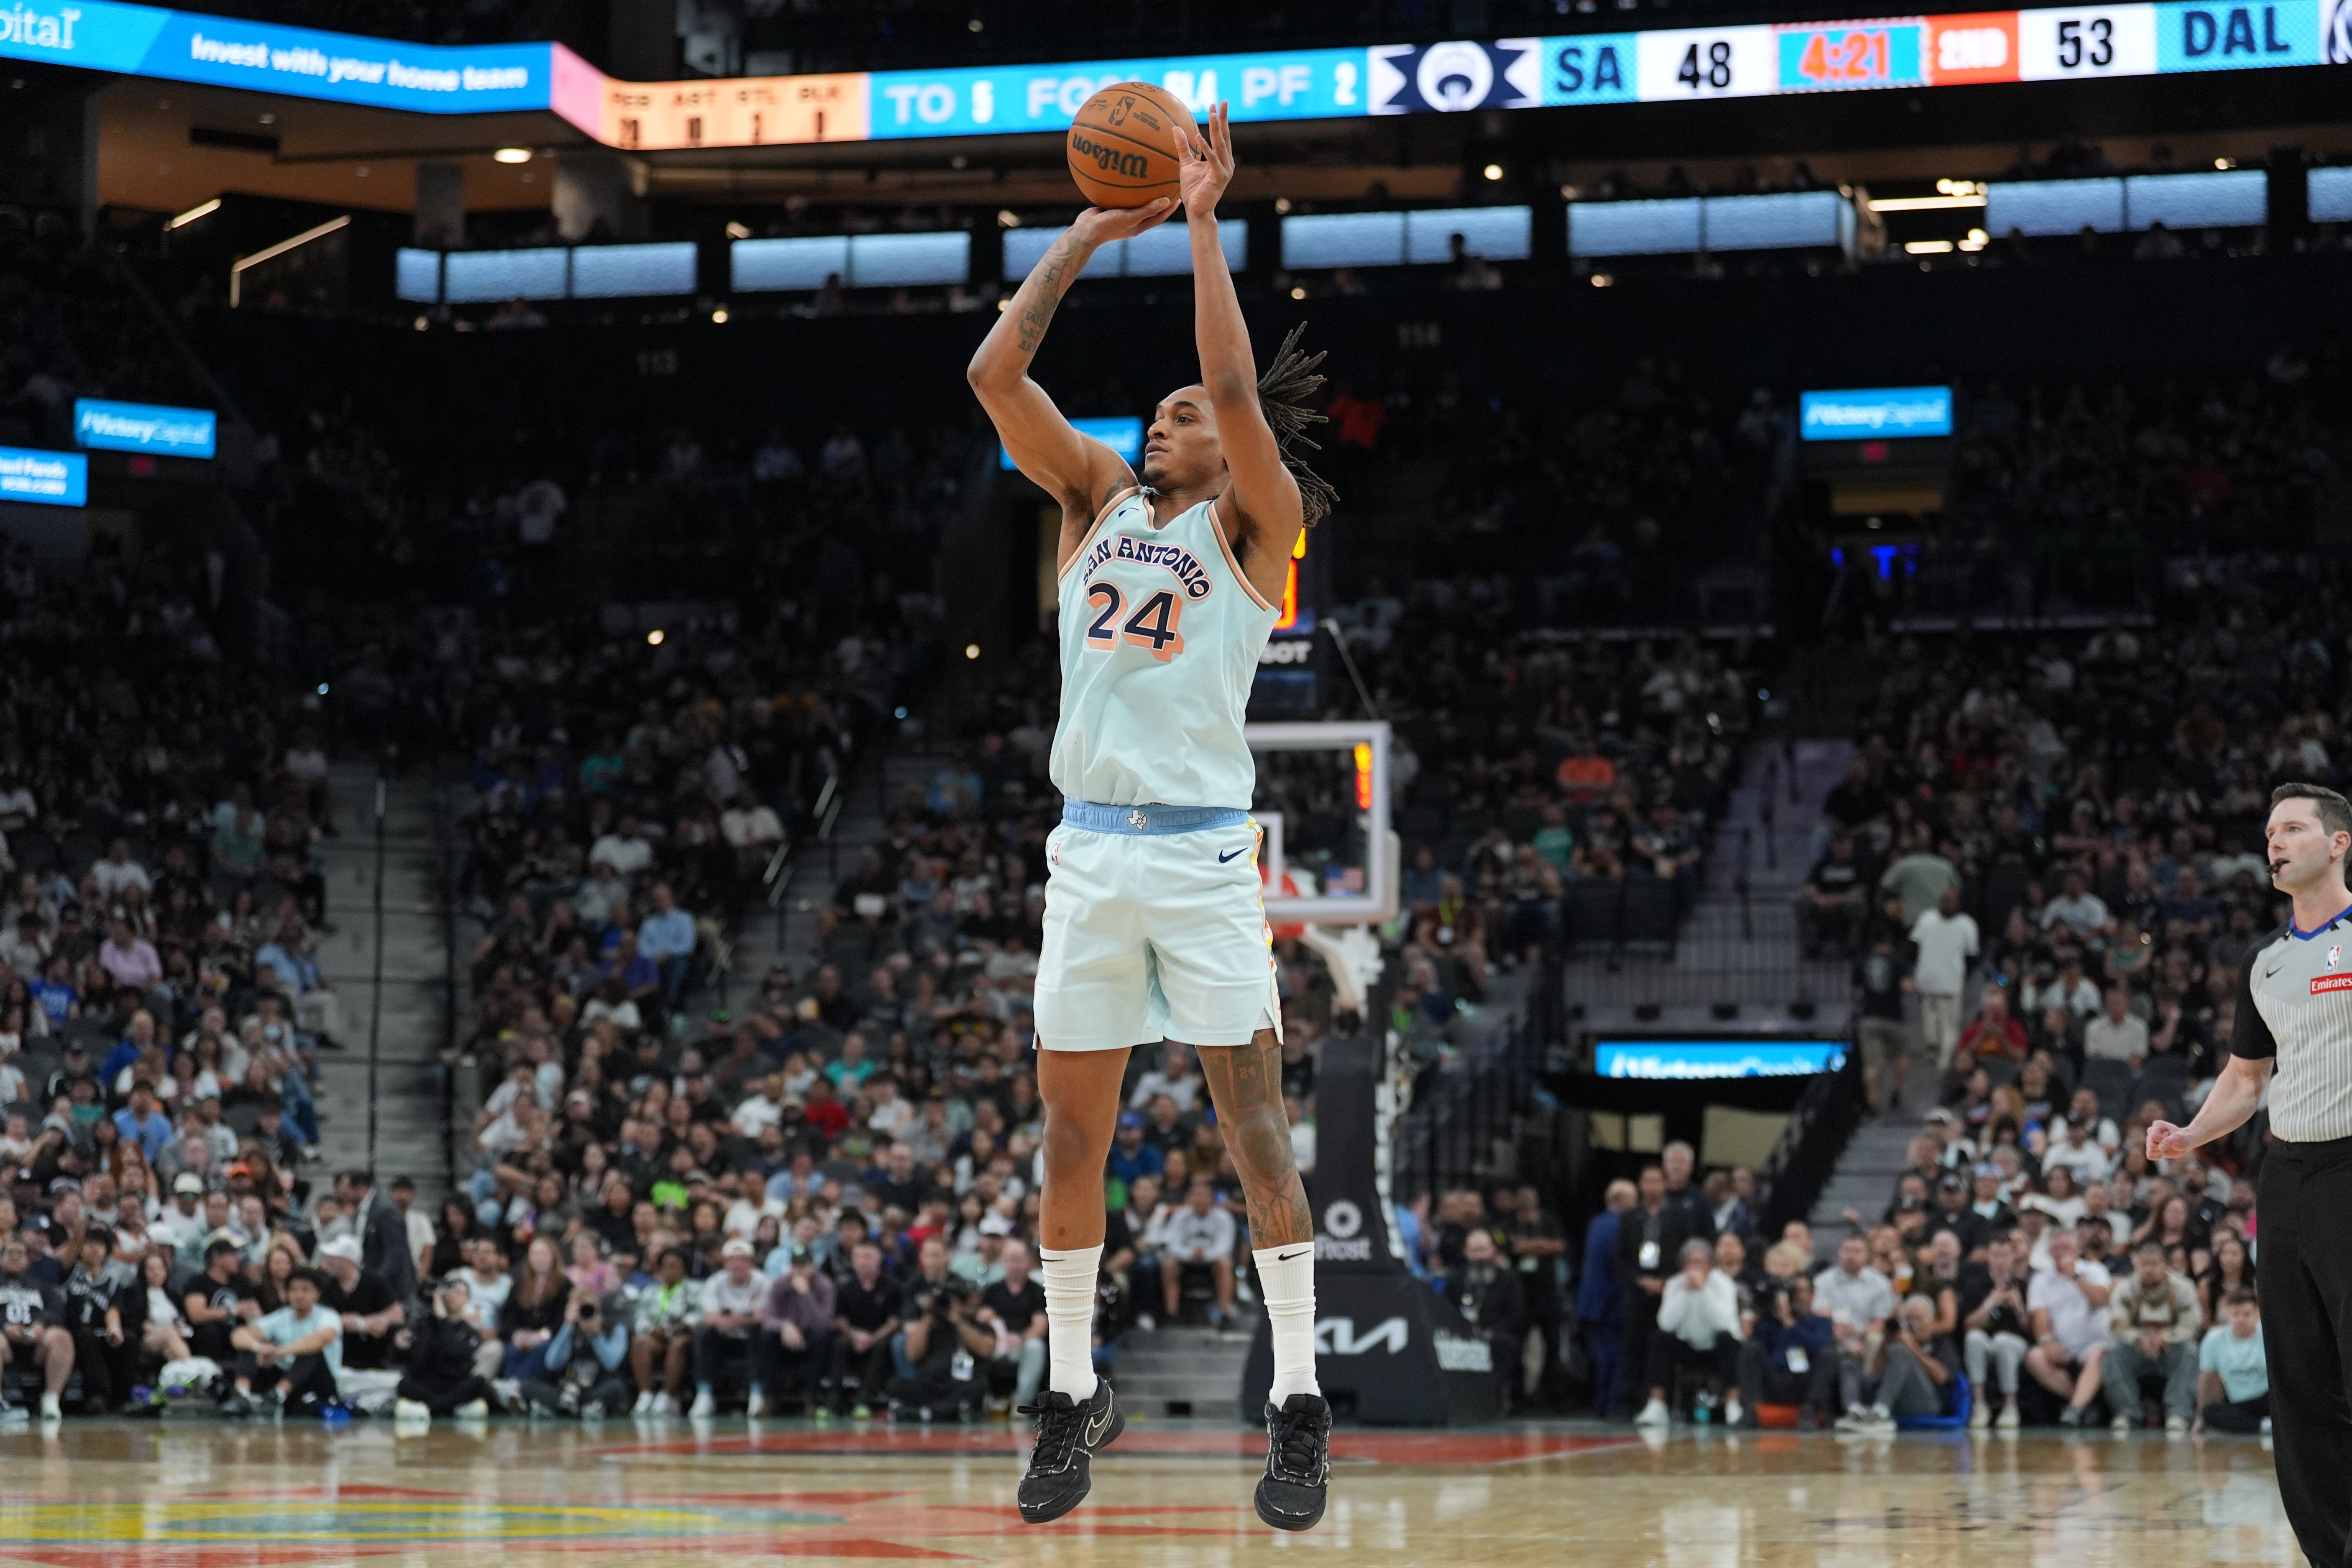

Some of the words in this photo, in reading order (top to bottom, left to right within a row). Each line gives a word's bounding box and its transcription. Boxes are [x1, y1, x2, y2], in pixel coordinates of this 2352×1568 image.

[191, 33, 269, 68] Invest
[271, 46, 328, 76] with
[327, 57, 388, 83] your
[388, 59, 460, 92] home
[462, 66, 528, 90] team
[1801, 31, 1889, 81] 4:21
[2058, 19, 2112, 67] 53
[2183, 8, 2291, 56] DAL
[1241, 65, 1311, 106] PF
[1334, 62, 1357, 105] 2
[1557, 47, 1622, 92] SA
[1678, 42, 1731, 89] 48
[884, 84, 956, 125] TO
[1073, 132, 1149, 179] Wilson
[1116, 536, 1211, 599] ANTONIO
[1086, 580, 1184, 661] 24
[2312, 978, 2352, 992] Emirates
